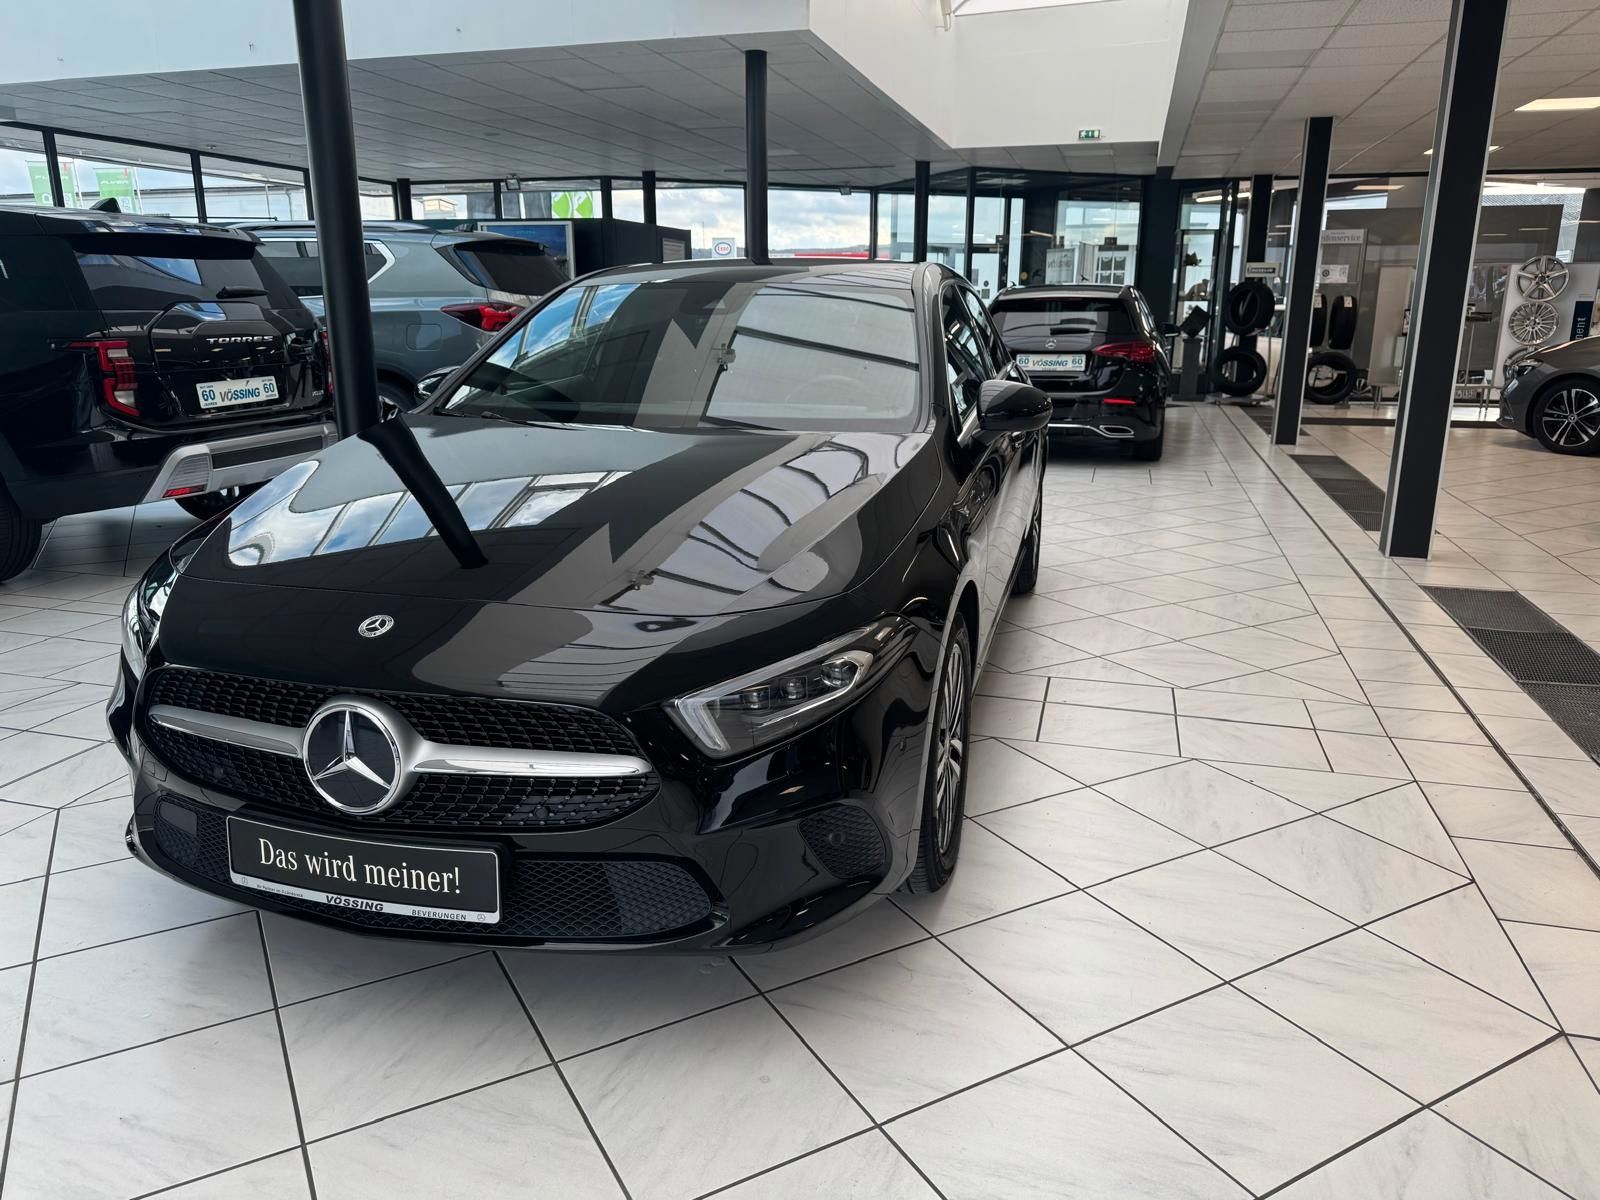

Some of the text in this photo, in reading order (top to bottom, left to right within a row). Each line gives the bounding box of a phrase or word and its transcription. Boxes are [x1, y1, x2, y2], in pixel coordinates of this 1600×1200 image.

[206, 336, 274, 345] TORRES
[1018, 357, 1083, 367] 60 VÖSSING 60
[201, 382, 275, 403] 60 VÖSSING 60
[258, 838, 460, 894] Das wird meiner!
[325, 895, 384, 912] VÖSSING
[411, 909, 467, 920] BEVERUNGEN
